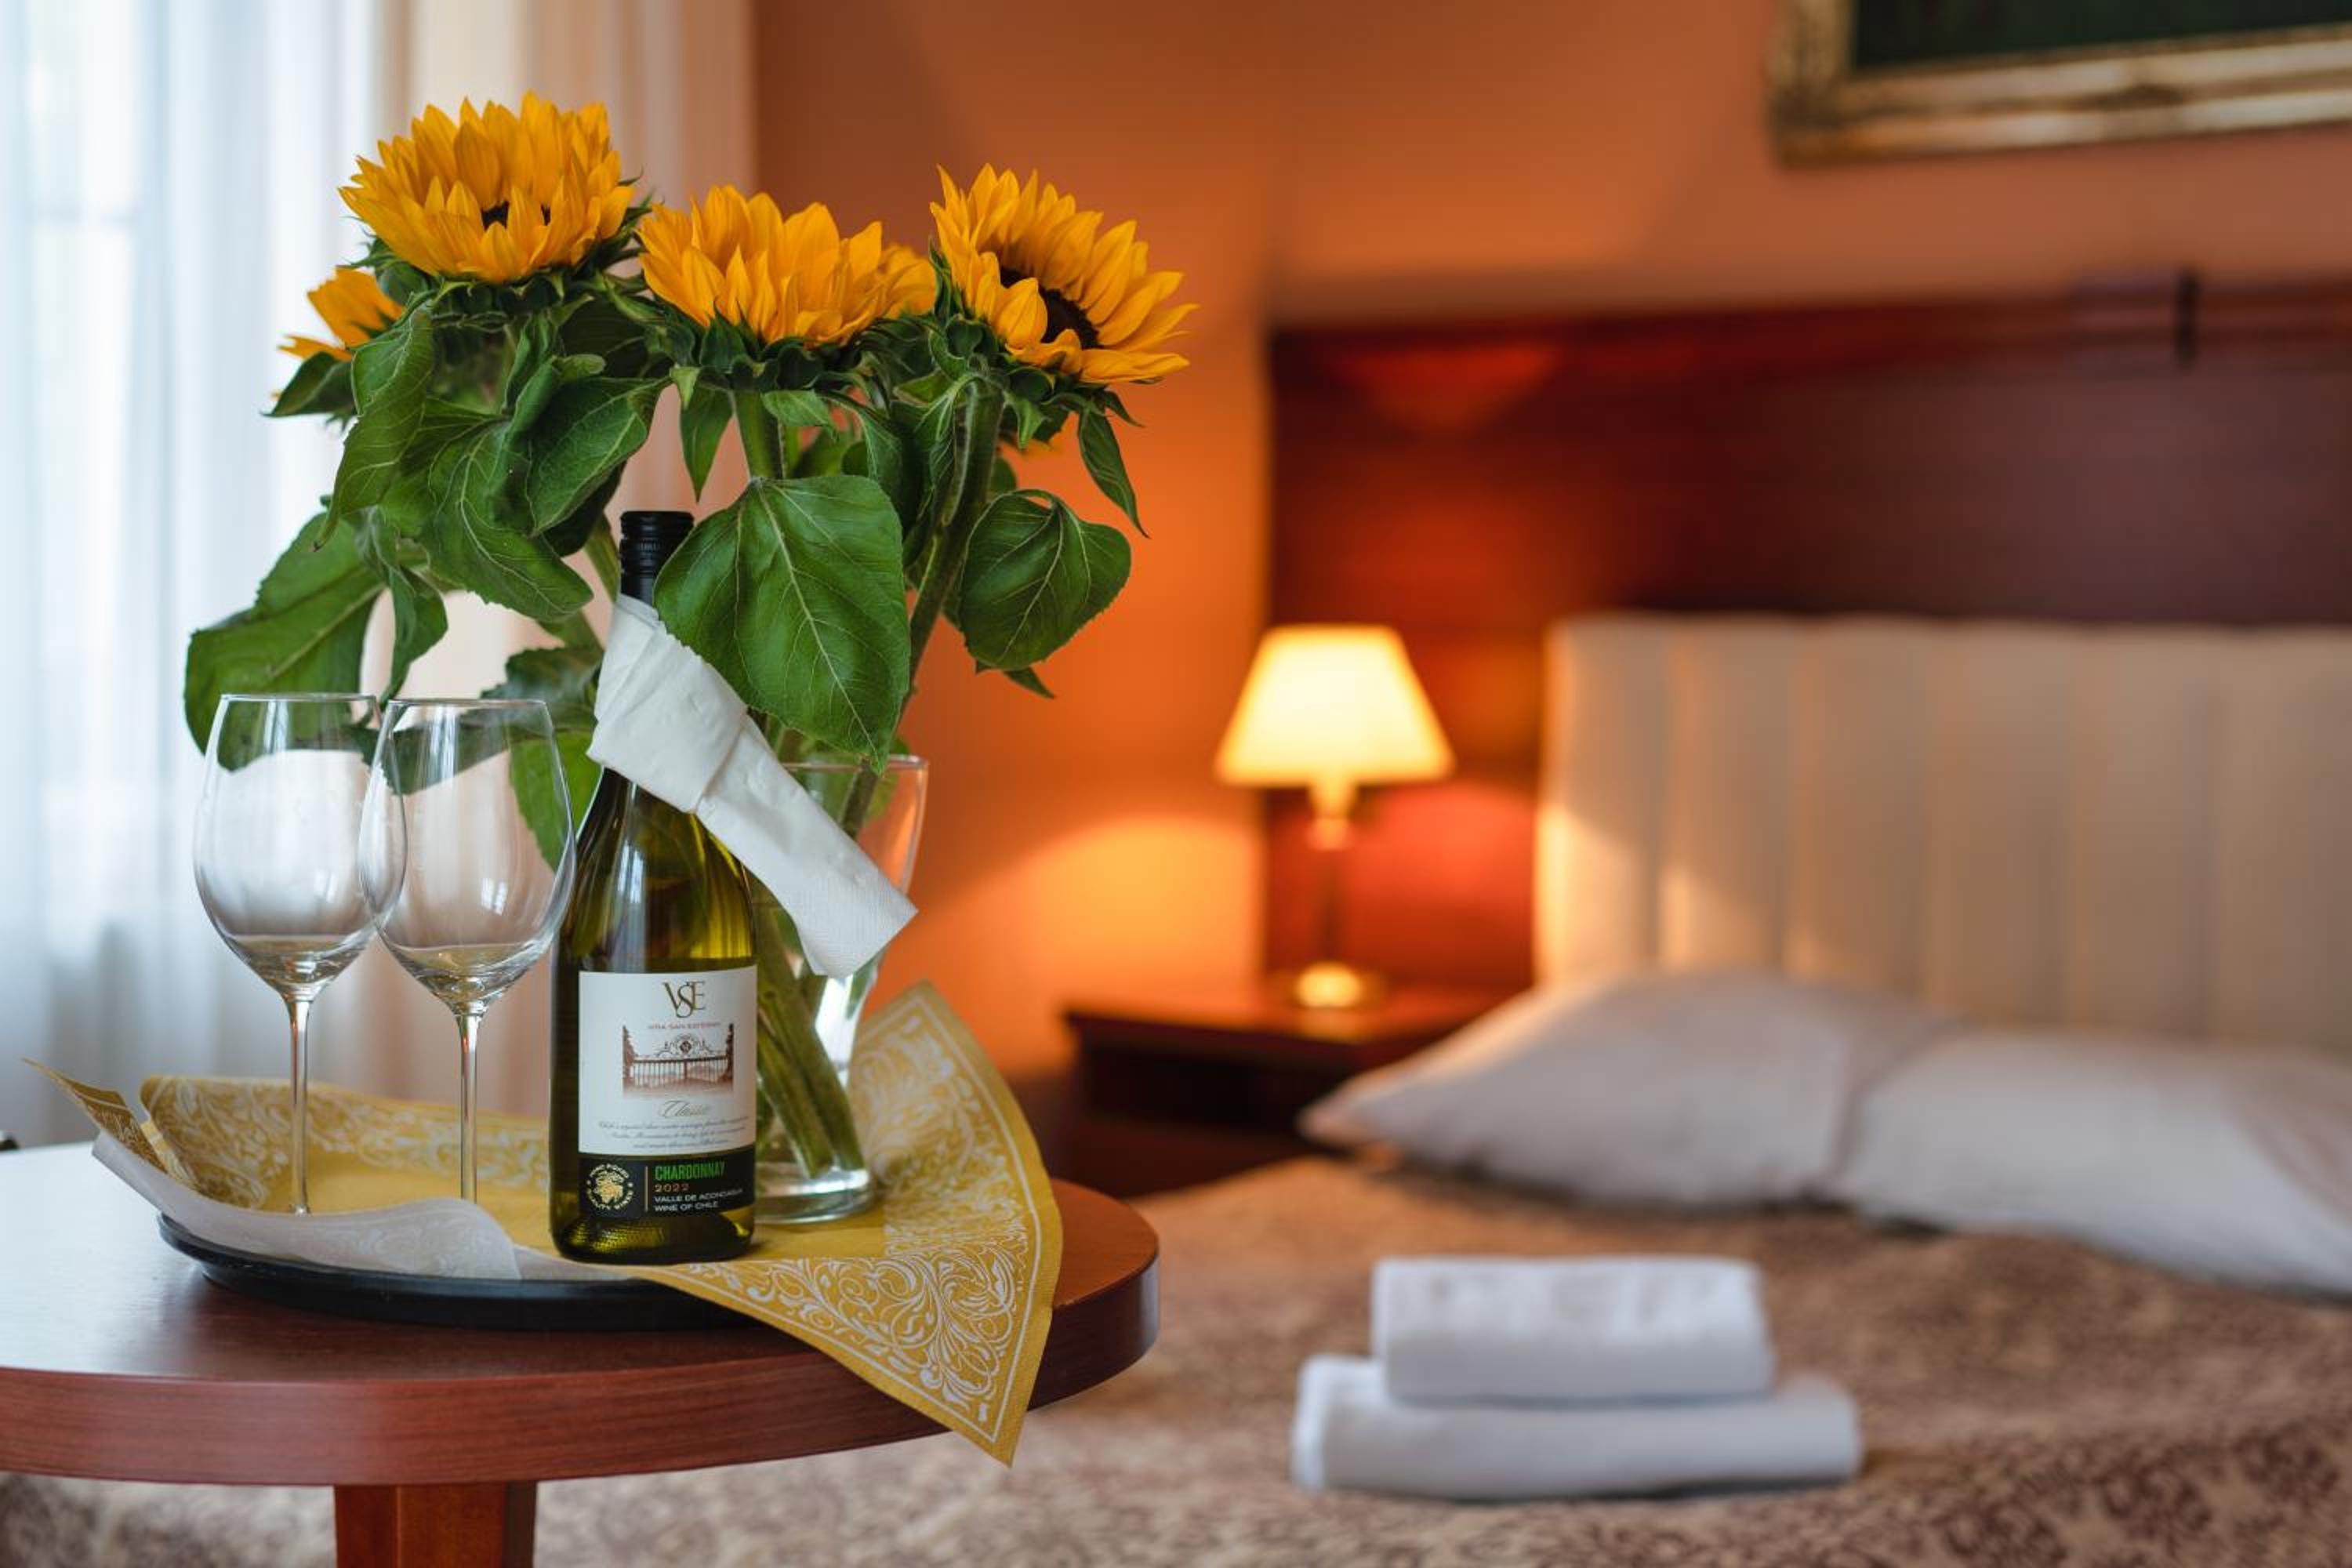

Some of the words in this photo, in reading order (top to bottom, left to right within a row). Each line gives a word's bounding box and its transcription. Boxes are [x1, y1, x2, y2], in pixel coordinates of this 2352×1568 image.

[655, 1161, 725, 1181] CHARDONNAY
[655, 1183, 689, 1192] 2022
[654, 1194, 683, 1203] VALLE
[695, 1200, 719, 1210] CHILE
